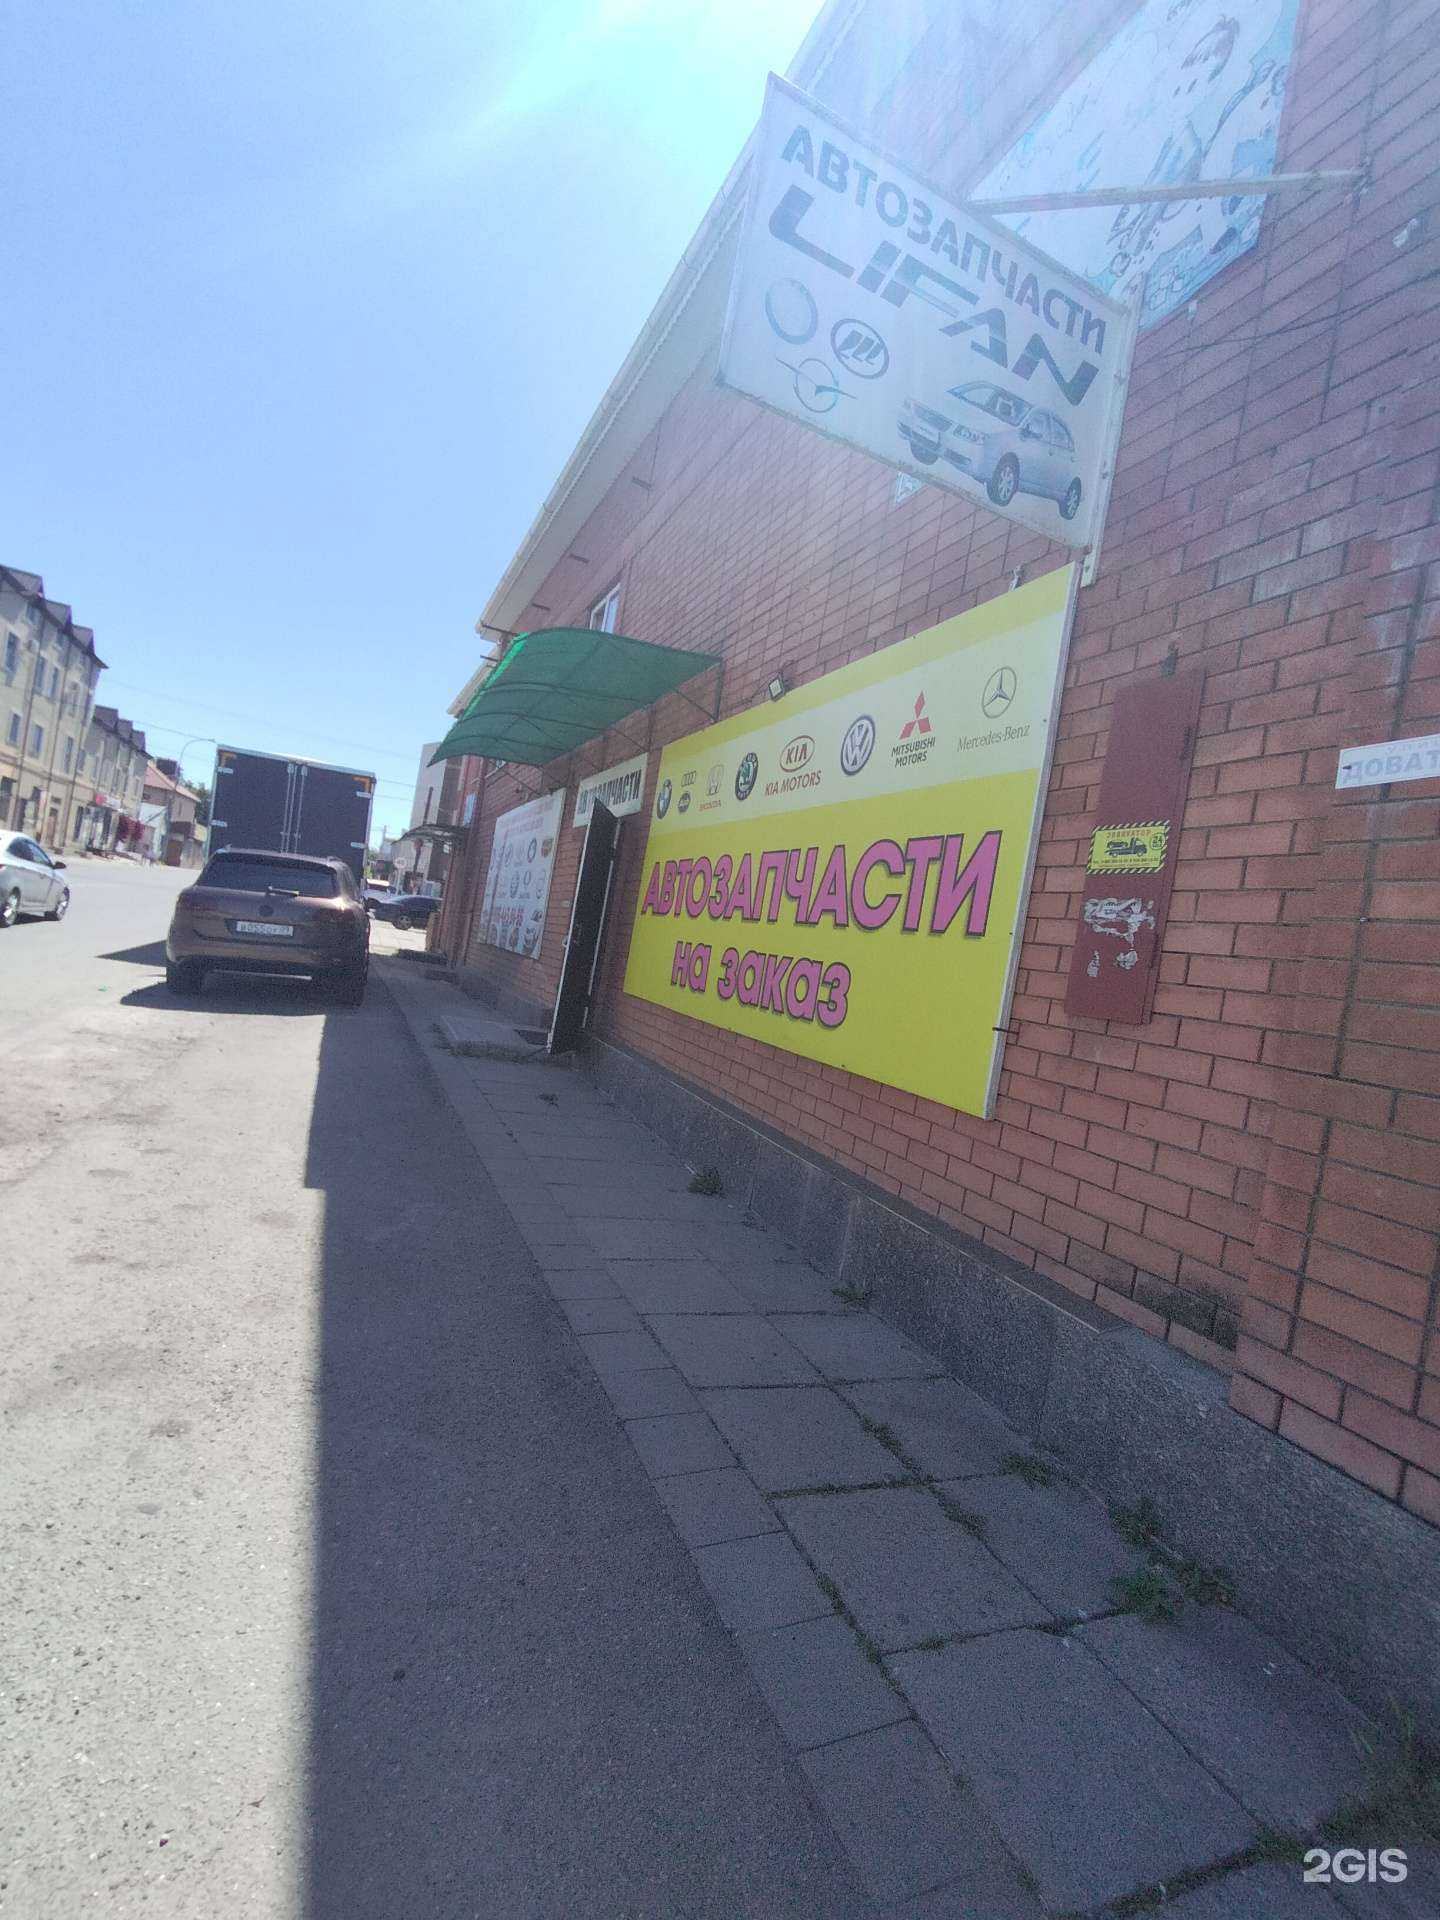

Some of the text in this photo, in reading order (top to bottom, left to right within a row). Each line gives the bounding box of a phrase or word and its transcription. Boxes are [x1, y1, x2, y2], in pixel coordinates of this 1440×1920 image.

[781, 124, 1107, 354] АВТОЗАПЧАСТИ
[768, 184, 1100, 407] LIFAN
[891, 736, 936, 757] MITSUBISHI
[957, 724, 1031, 752] Mercedes-Benz
[785, 741, 809, 765] KIA
[894, 750, 928, 768] MOTORS
[764, 780, 779, 797] KIA
[780, 769, 822, 794] MOTORS
[641, 829, 1003, 939] АВТОЗАПЧАСТИ
[670, 940, 852, 1029] на заказ
